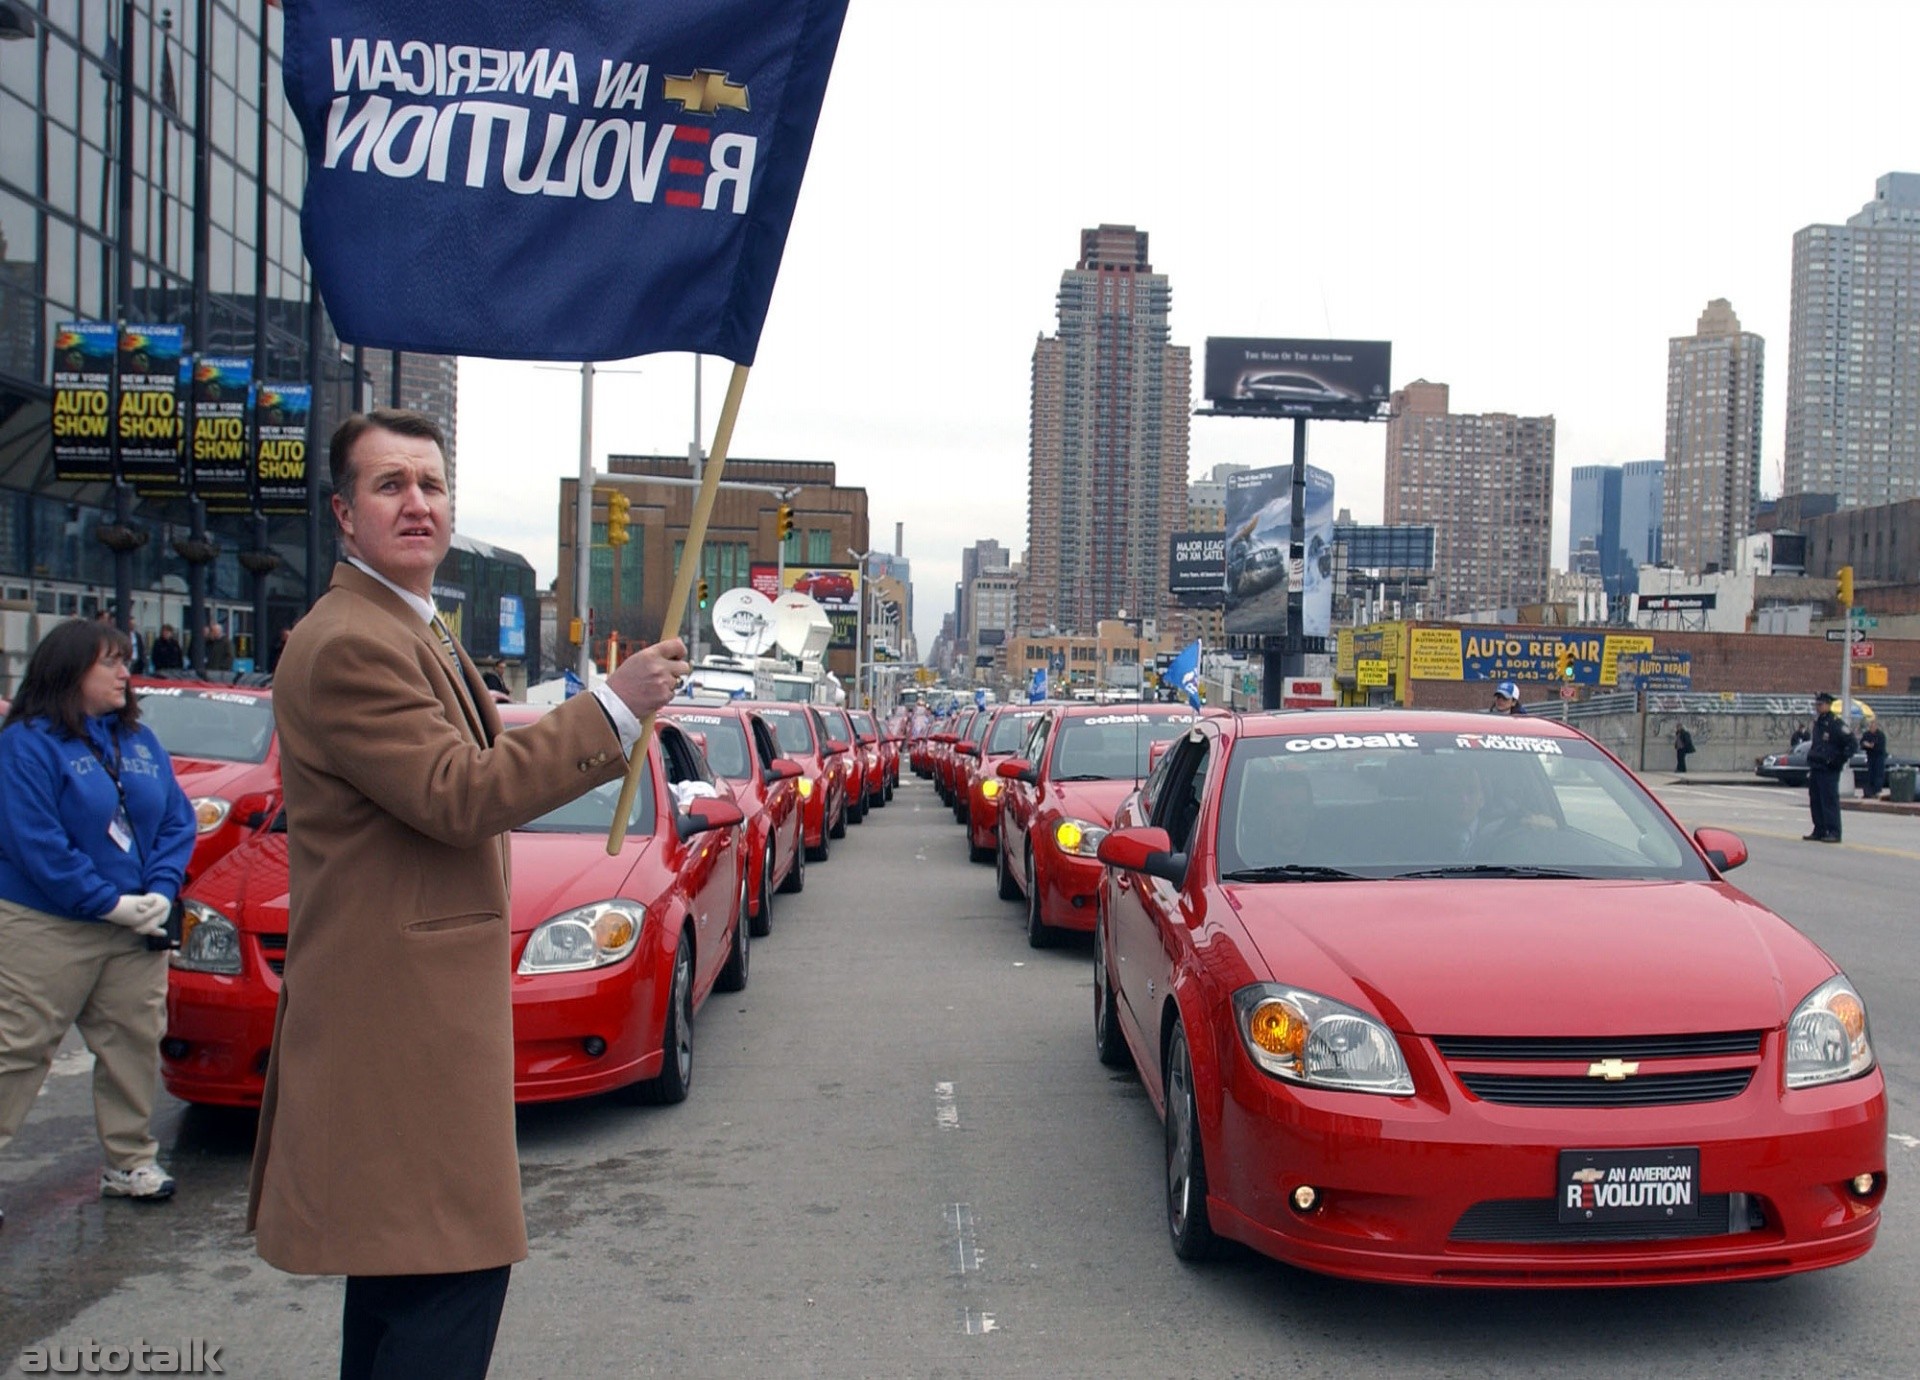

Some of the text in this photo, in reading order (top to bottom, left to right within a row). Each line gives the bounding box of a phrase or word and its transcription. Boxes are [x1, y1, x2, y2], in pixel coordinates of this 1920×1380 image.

[54, 391, 109, 415] AUTO
[120, 392, 175, 416] AUTO
[54, 415, 109, 437] SHOW
[120, 416, 175, 438] SHOW
[194, 419, 243, 440] AUTO
[194, 440, 244, 460] SHOW
[259, 441, 305, 460] AUTO
[259, 460, 305, 479] SHOW
[1176, 541, 1202, 551] MAJOR
[1176, 551, 1188, 561] ON
[1466, 637, 1522, 659] AUTO
[1529, 640, 1600, 662] REPAIR
[1507, 660, 1536, 669] BODY
[1541, 661, 1565, 669] SHO
[1640, 660, 1691, 678] AUTO REPAIR
[1084, 714, 1150, 725] cobalt
[1285, 732, 1419, 752] cobalt
[1607, 1166, 1691, 1182] AN AMERICAN
[1567, 1182, 1692, 1208] REVOLUTION
